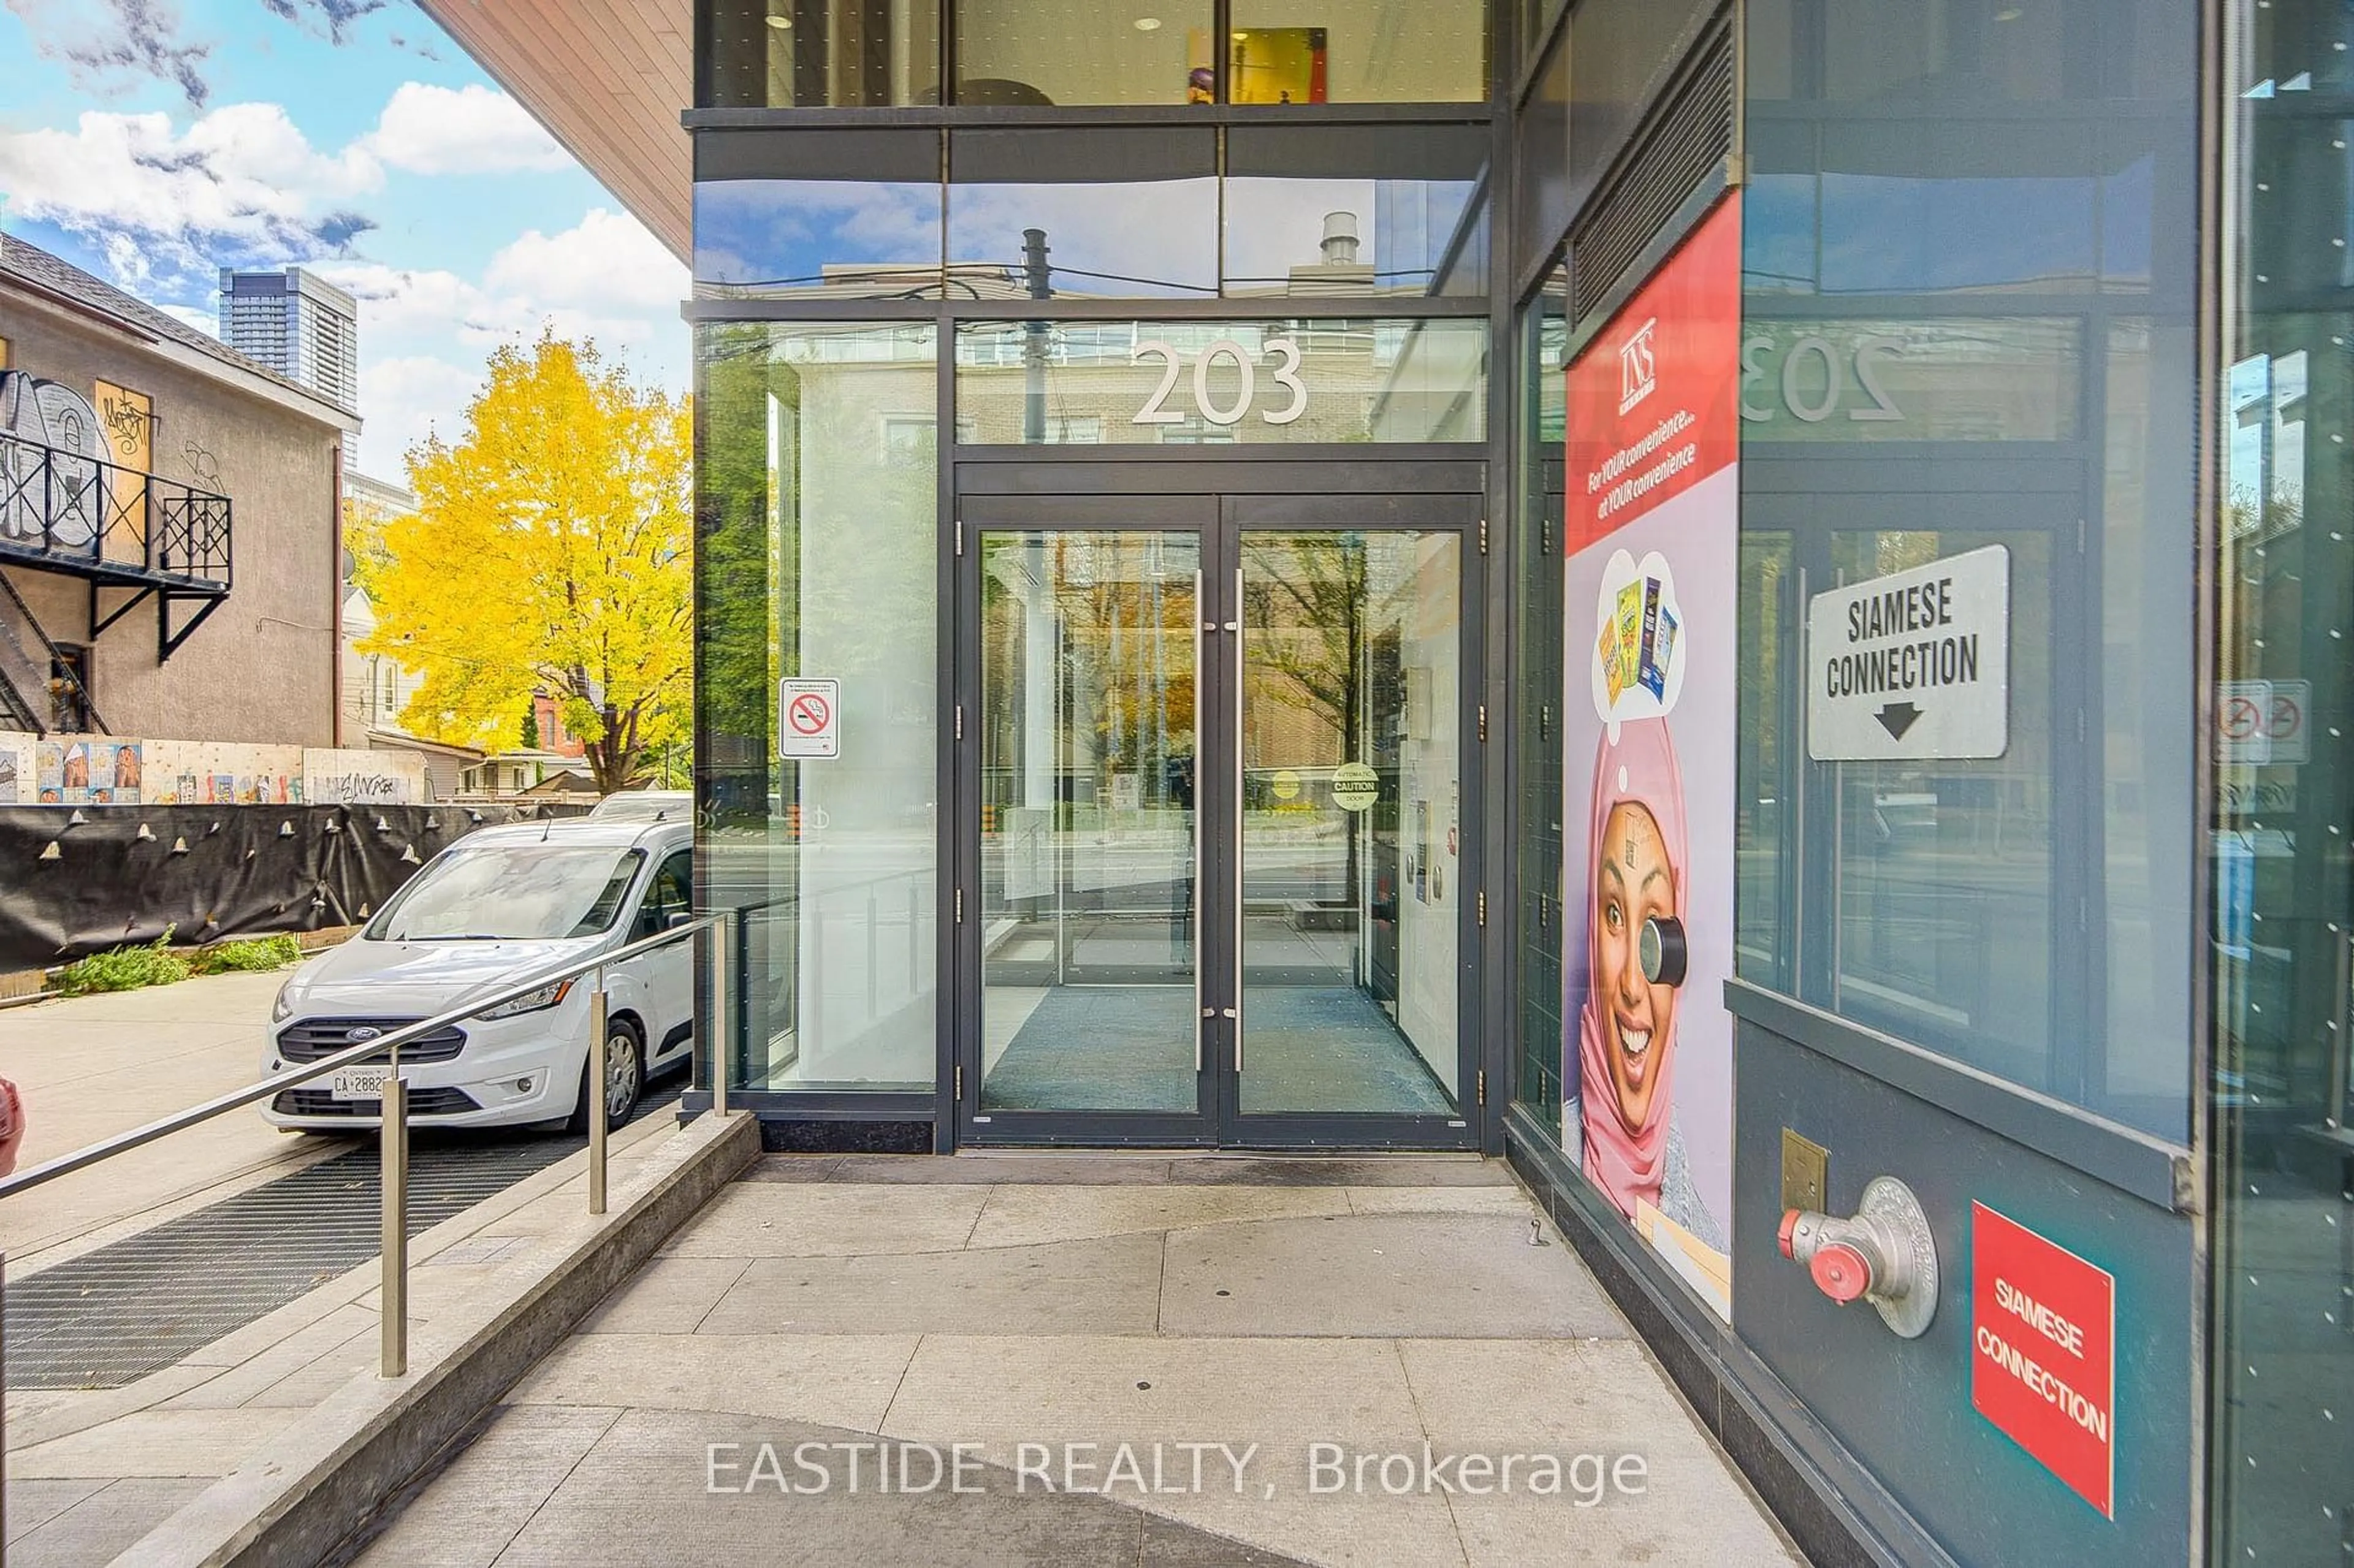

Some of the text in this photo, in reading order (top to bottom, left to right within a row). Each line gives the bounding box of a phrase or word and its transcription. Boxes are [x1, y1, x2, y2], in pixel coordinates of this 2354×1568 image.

[1132, 340, 1308, 425] 203
[1621, 325, 1655, 403] INS
[1588, 471, 1602, 494] For
[1601, 449, 1626, 484] YOUR
[1598, 442, 1696, 519] at YOUR convenience
[1848, 577, 1952, 643] SIAMESE
[1827, 634, 1978, 698] CONNECTION
[1334, 782, 1375, 791] CAUTION
[334, 1076, 386, 1092] CA 2882
[1994, 1277, 2084, 1360] SIAMESE
[1977, 1325, 2107, 1443] CONNECTION
